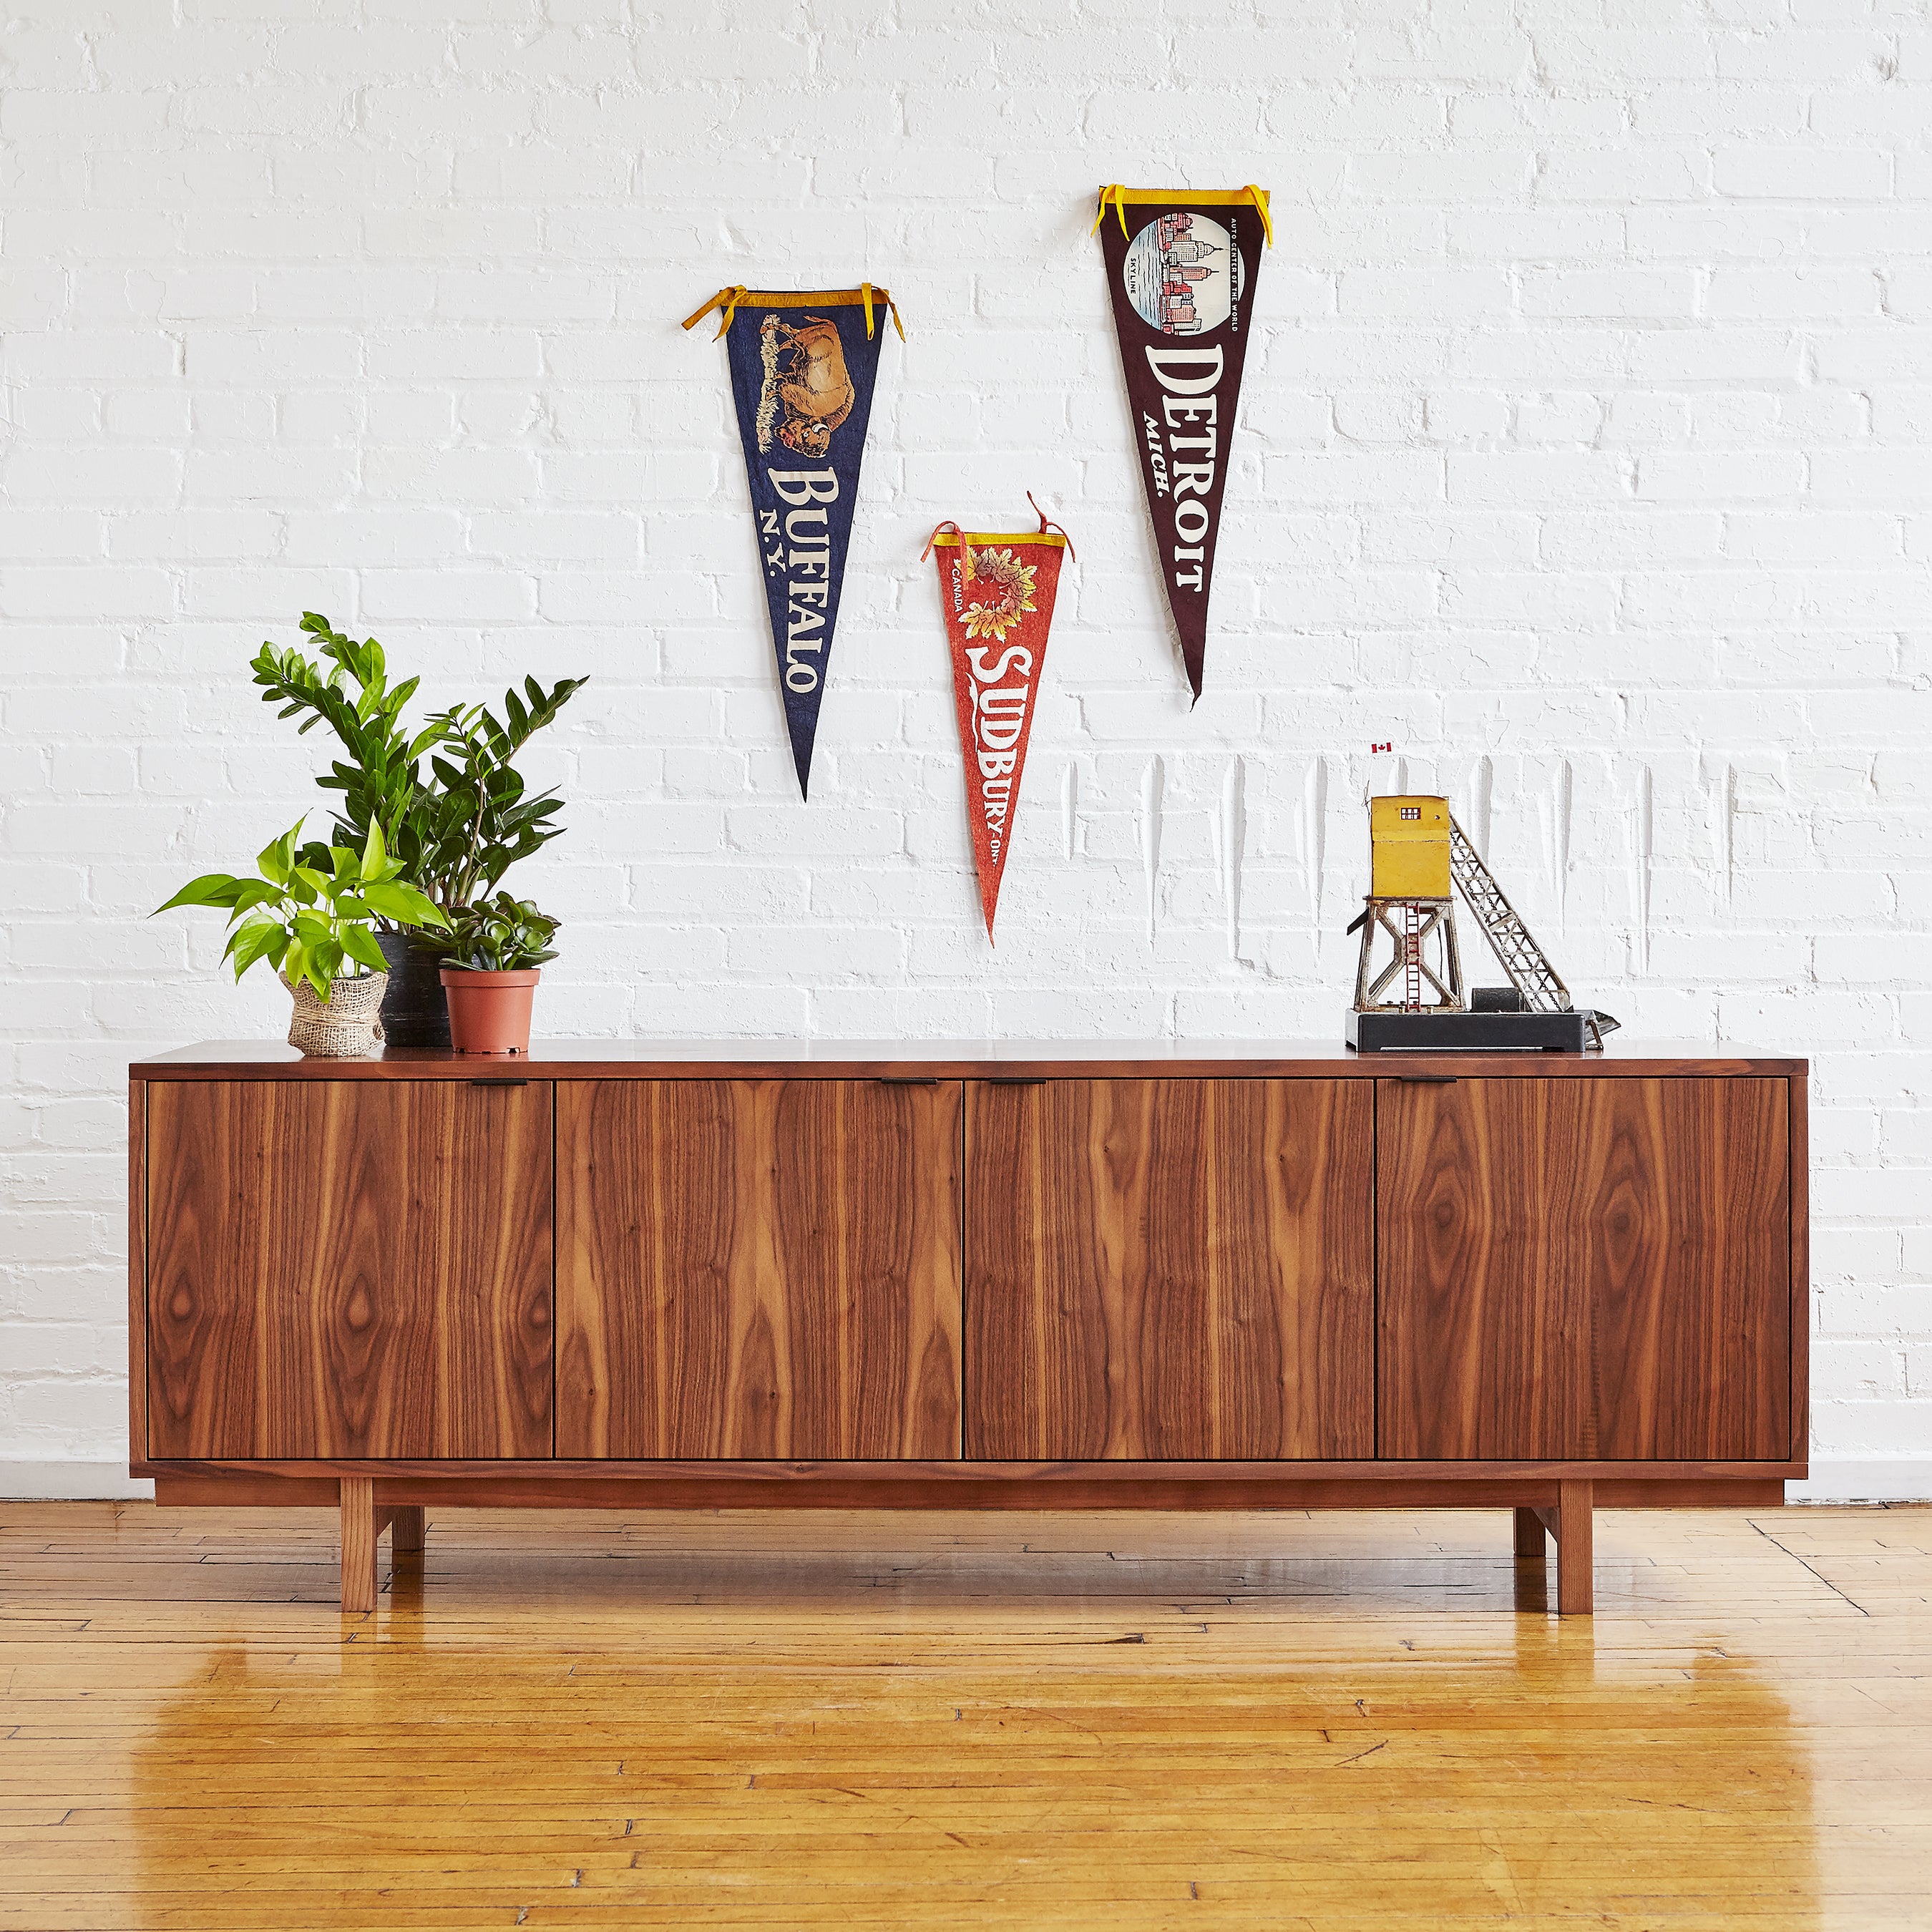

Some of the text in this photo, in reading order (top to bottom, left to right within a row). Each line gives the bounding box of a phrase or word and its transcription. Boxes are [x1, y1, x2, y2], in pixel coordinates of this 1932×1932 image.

[1231, 275, 1237, 283] OF
[1143, 410, 1170, 498] MICH.
[1145, 343, 1224, 592] DETROIT
[767, 466, 839, 693] BUFFALO
[952, 568, 963, 613] CANADA
